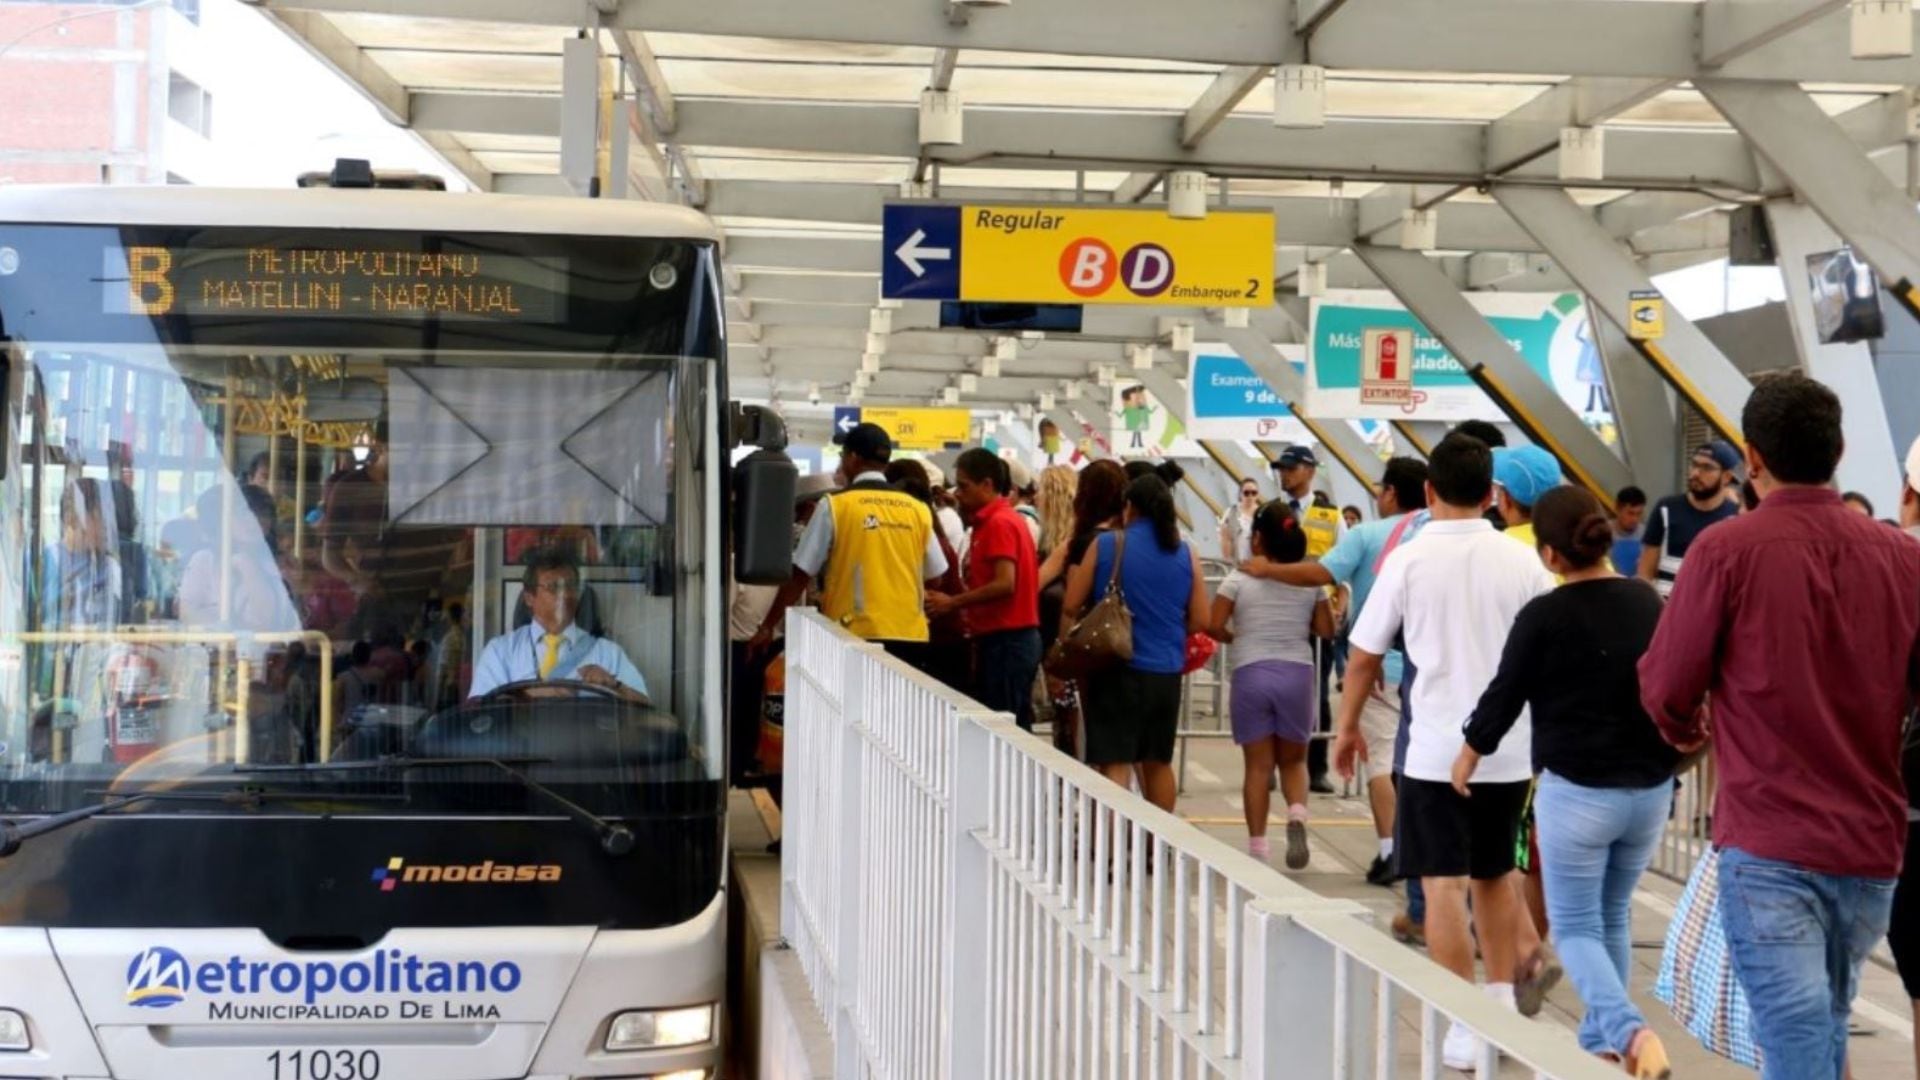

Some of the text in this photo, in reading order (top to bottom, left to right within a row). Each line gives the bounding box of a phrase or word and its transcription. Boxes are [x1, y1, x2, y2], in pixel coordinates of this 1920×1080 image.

[976, 209, 1064, 234] Regular
[248, 248, 480, 278] METROPOLITANO
[1070, 244, 1171, 290] B D
[128, 246, 175, 315] B
[1170, 279, 1261, 300] Embarque 2
[203, 279, 341, 311] MATELLINI
[371, 282, 522, 314] NARANJAL
[1211, 373, 1264, 387] Examen
[1244, 390, 1255, 404] 9
[1257, 389, 1277, 404] de
[1363, 388, 1410, 400] EXTINTOR
[403, 861, 562, 883] modasa
[127, 946, 522, 1008] Metropolitano
[266, 1049, 381, 1080] 11030
